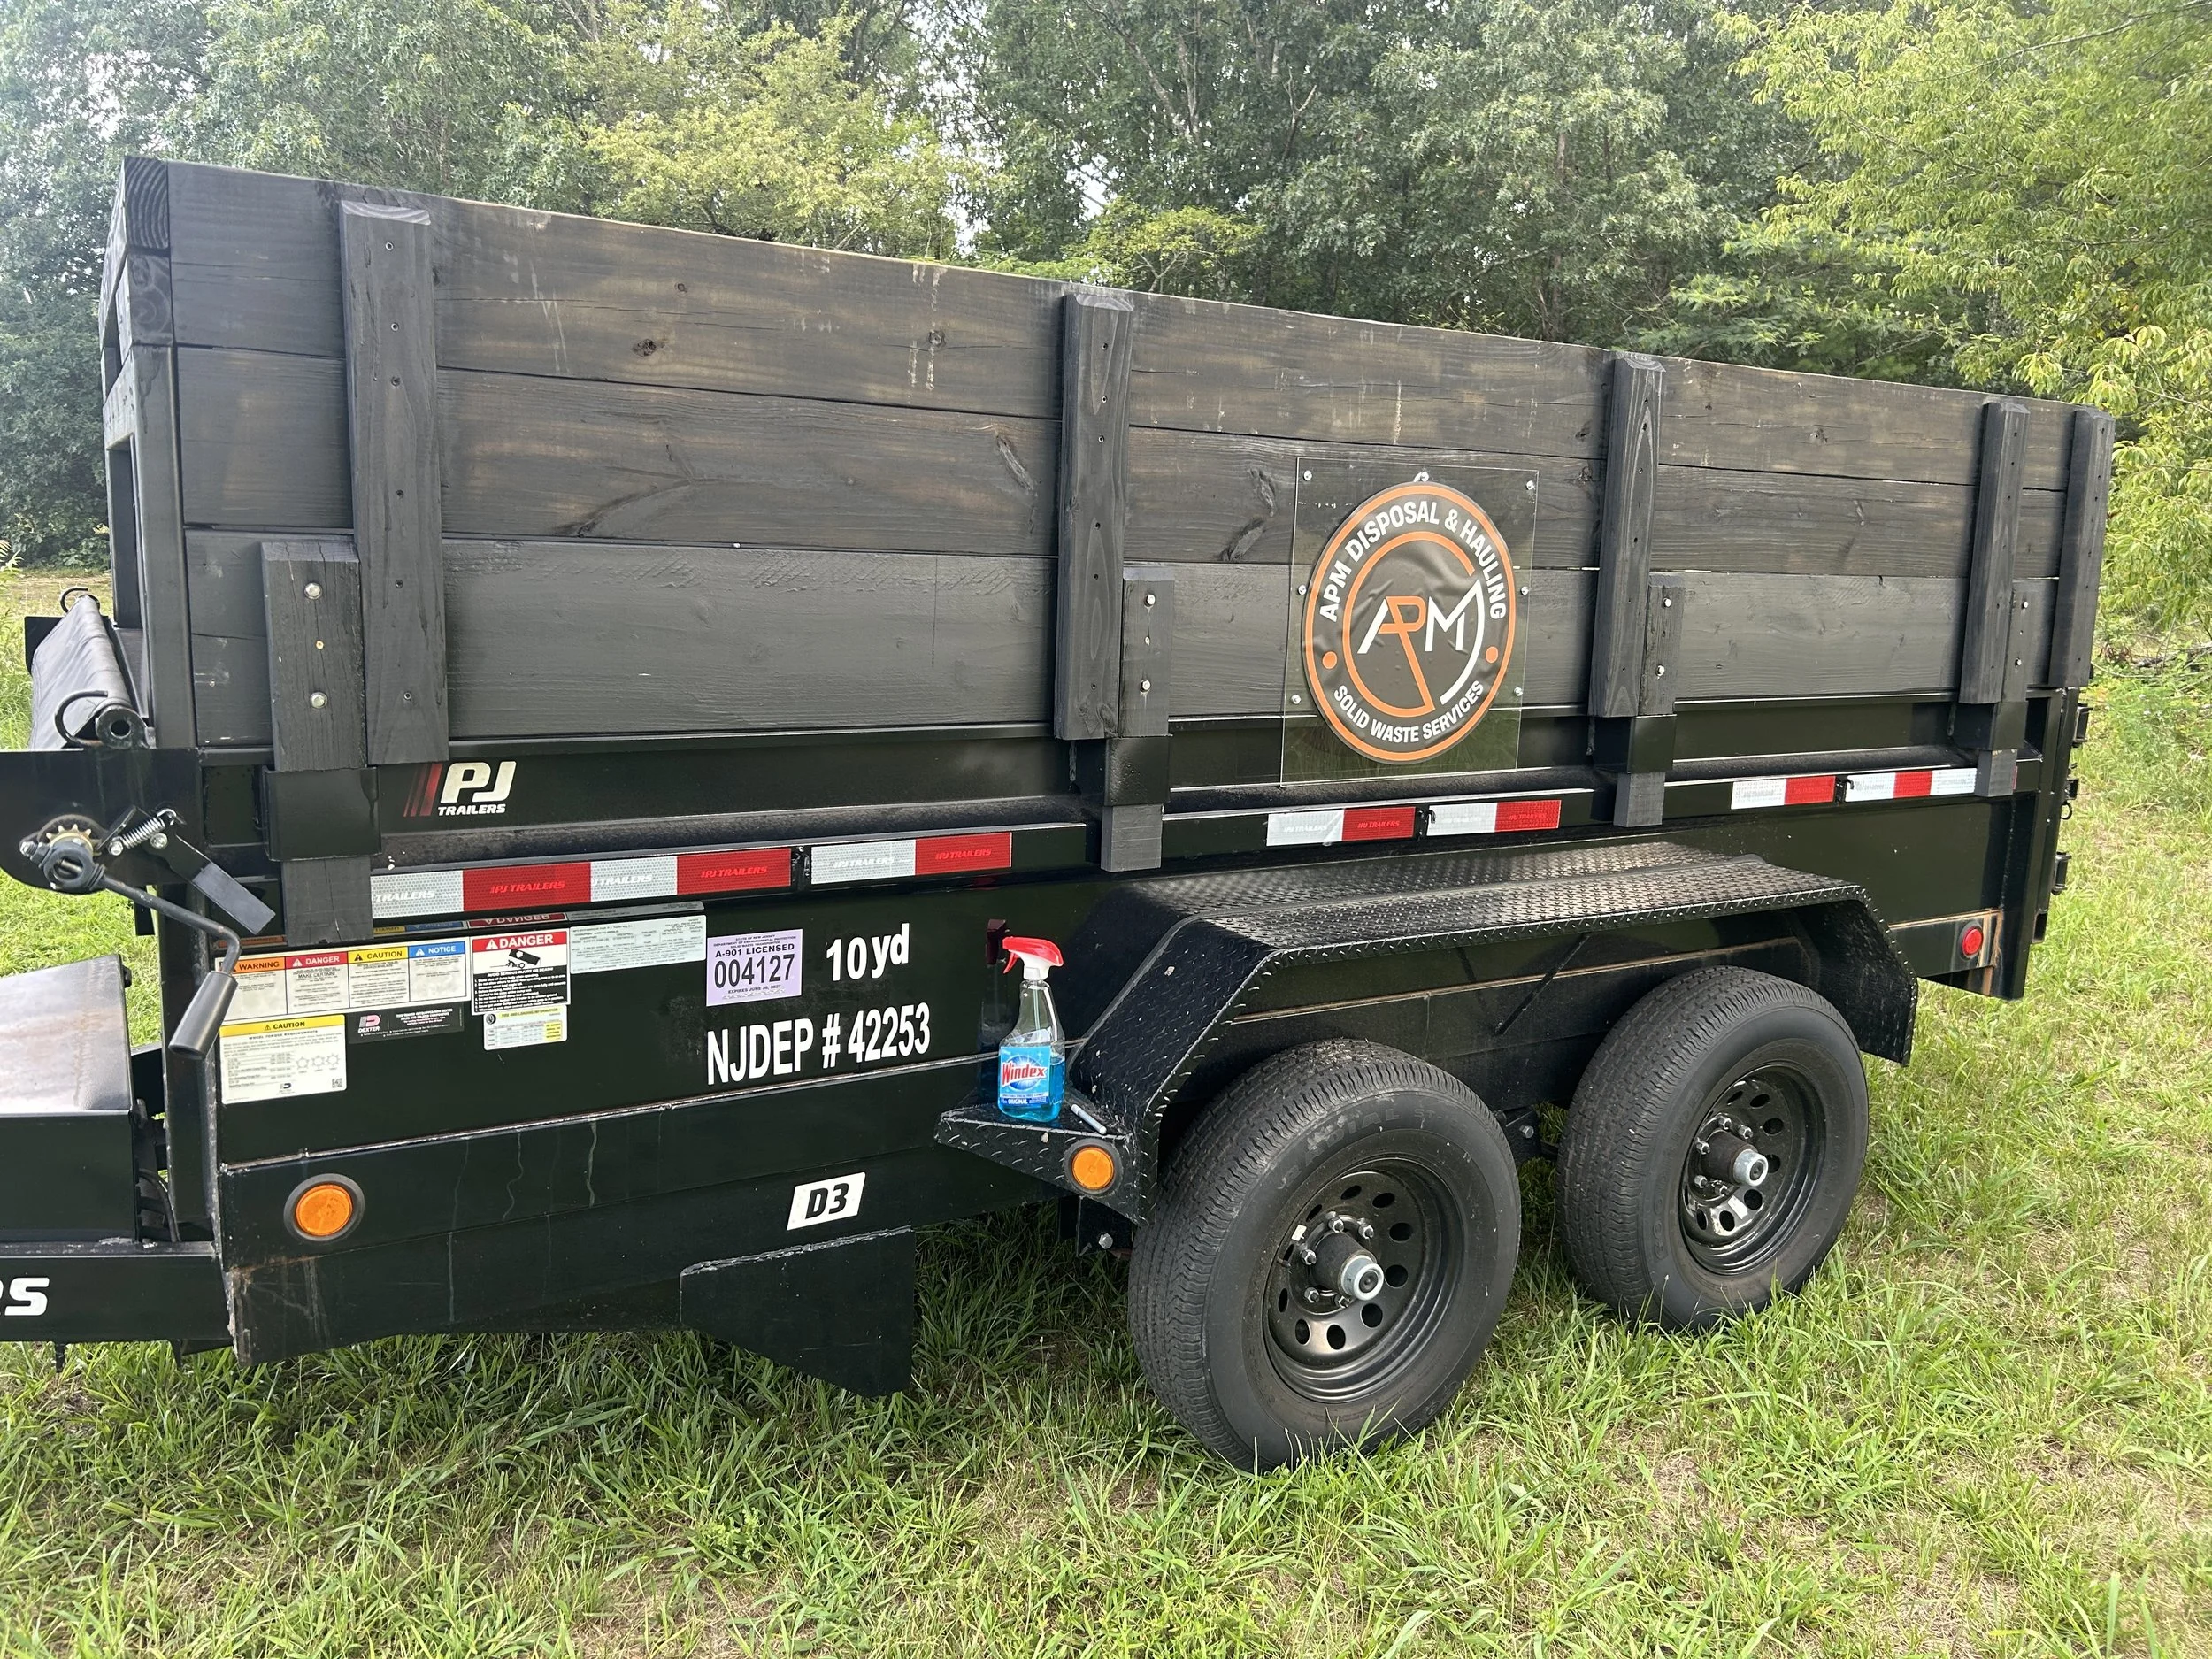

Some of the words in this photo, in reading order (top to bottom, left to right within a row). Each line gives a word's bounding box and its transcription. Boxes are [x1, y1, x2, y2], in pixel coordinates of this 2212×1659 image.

[1320, 560, 1352, 622] APM
[1345, 501, 1440, 563] DISPOSAL
[1444, 509, 1458, 531] &
[1460, 519, 1507, 620] HAULING
[1357, 580, 1486, 657] APM
[1334, 686, 1370, 729] SOLID
[1371, 718, 1419, 743] WASTE
[1422, 680, 1484, 740] SERVICES
[441, 761, 517, 803] PJ
[438, 804, 507, 816] TRAILERS
[949, 849, 992, 858] TRAILERS
[849, 856, 895, 867] TRAILERS
[718, 866, 768, 877] TRAILERS
[510, 880, 566, 892] TRAILERS
[599, 874, 653, 886] TRAILERS
[375, 890, 436, 902] TRAILERS
[499, 933, 554, 948] DANGER
[366, 950, 403, 960] CAUTION
[428, 945, 457, 954] NOTICE
[715, 949, 742, 957] A-901
[746, 943, 795, 955] LICENSED
[239, 961, 280, 971] WARNING
[305, 956, 340, 965] DANGER
[714, 953, 795, 988] 004127
[273, 1021, 305, 1030] CAUTION
[707, 1018, 814, 1085] NJDEP
[822, 1013, 841, 1069] #
[848, 1002, 930, 1063] 42253
[1002, 1062, 1045, 1086] Windex
[805, 1183, 849, 1219] D3
